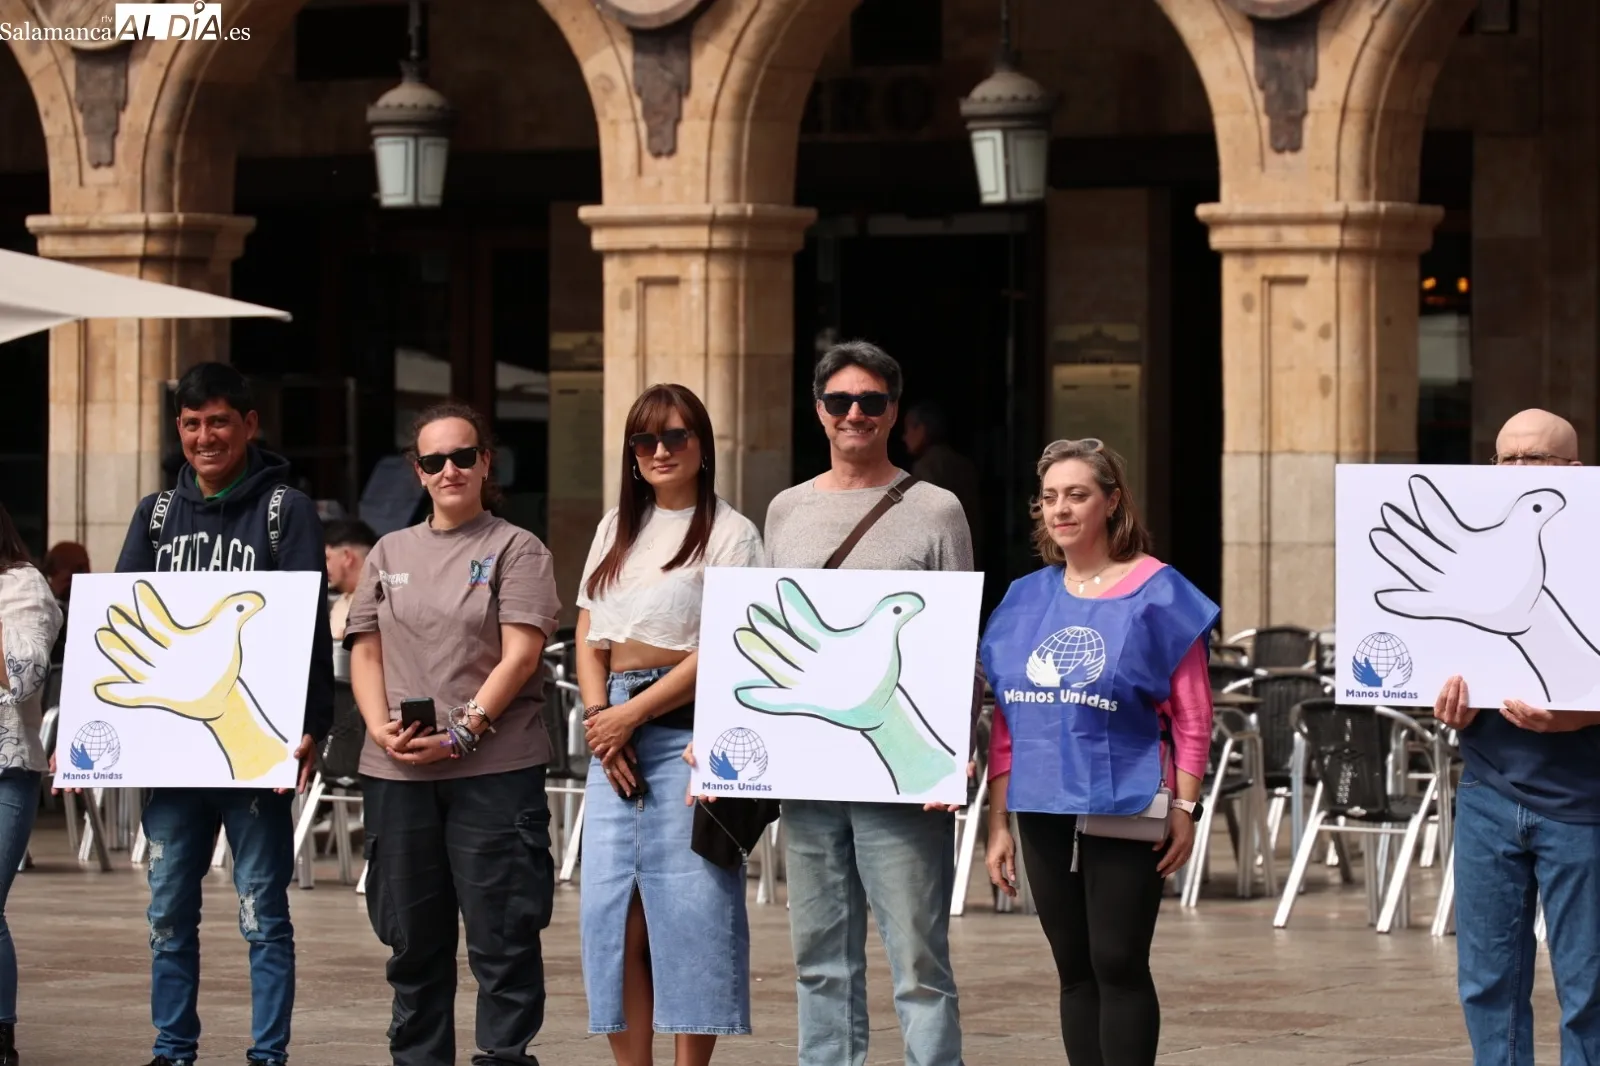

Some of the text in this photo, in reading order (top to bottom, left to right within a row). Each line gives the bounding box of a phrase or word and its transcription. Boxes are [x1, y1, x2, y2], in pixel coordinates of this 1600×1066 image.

[151, 498, 170, 530] LOLA
[269, 488, 285, 521] LOLA
[155, 531, 256, 572] CHICAGO
[1004, 688, 1119, 712] Manos Unidas
[1345, 688, 1419, 700] Manos Unidas
[62, 772, 123, 780] Manos Unidas
[702, 781, 773, 793] Manos Unidas
